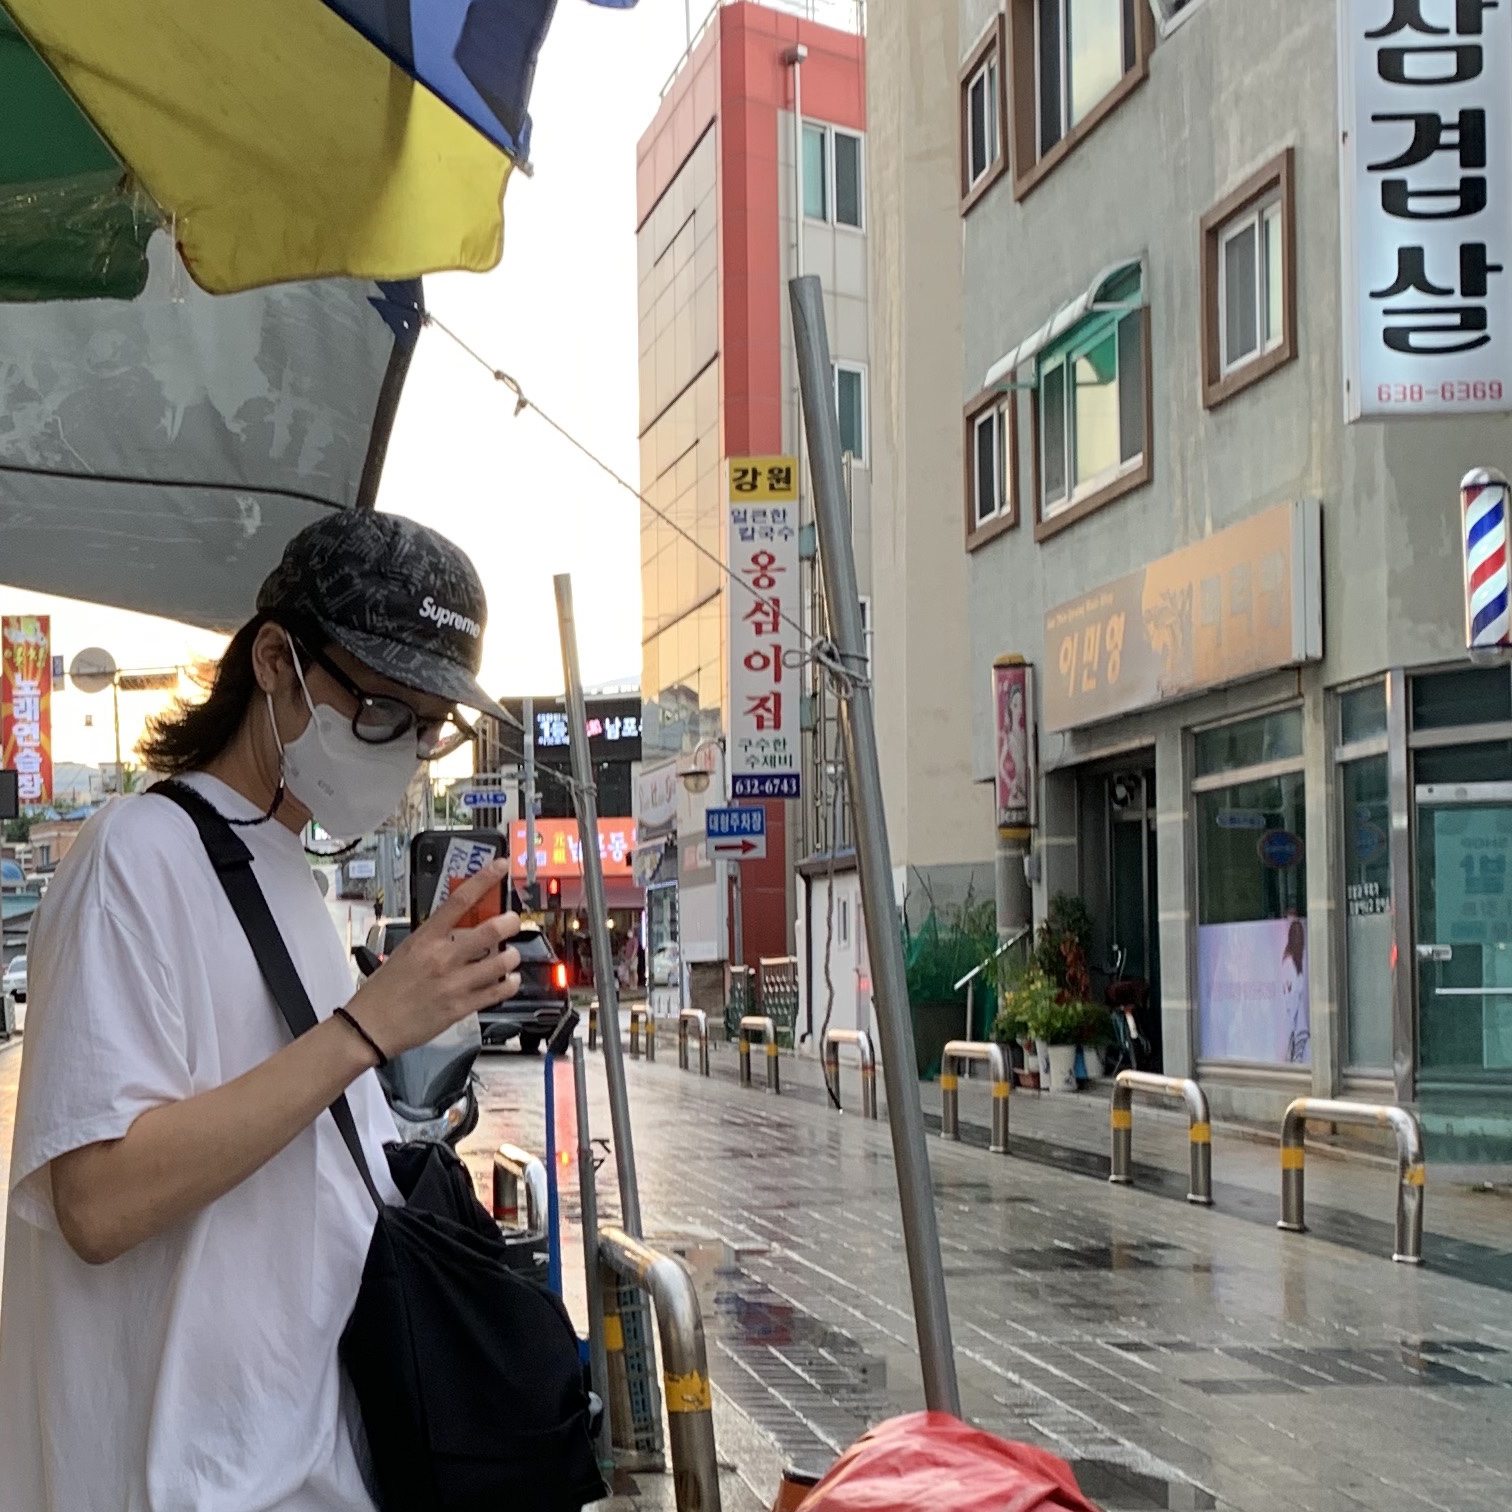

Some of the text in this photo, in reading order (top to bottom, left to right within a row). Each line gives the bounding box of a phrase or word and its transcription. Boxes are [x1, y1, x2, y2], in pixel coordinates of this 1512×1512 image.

[1364, 0, 1504, 355] 삼겹살
[1377, 380, 1503, 402] 638-6369
[732, 466, 792, 492] 강원
[738, 525, 795, 542] 칼국수
[418, 595, 481, 639] Supreme
[741, 549, 787, 732] 옹심이집
[1058, 610, 1126, 698] 이민영
[12, 672, 43, 798] 노래연습장
[605, 717, 642, 740] 남포
[735, 777, 797, 795] 632-6743
